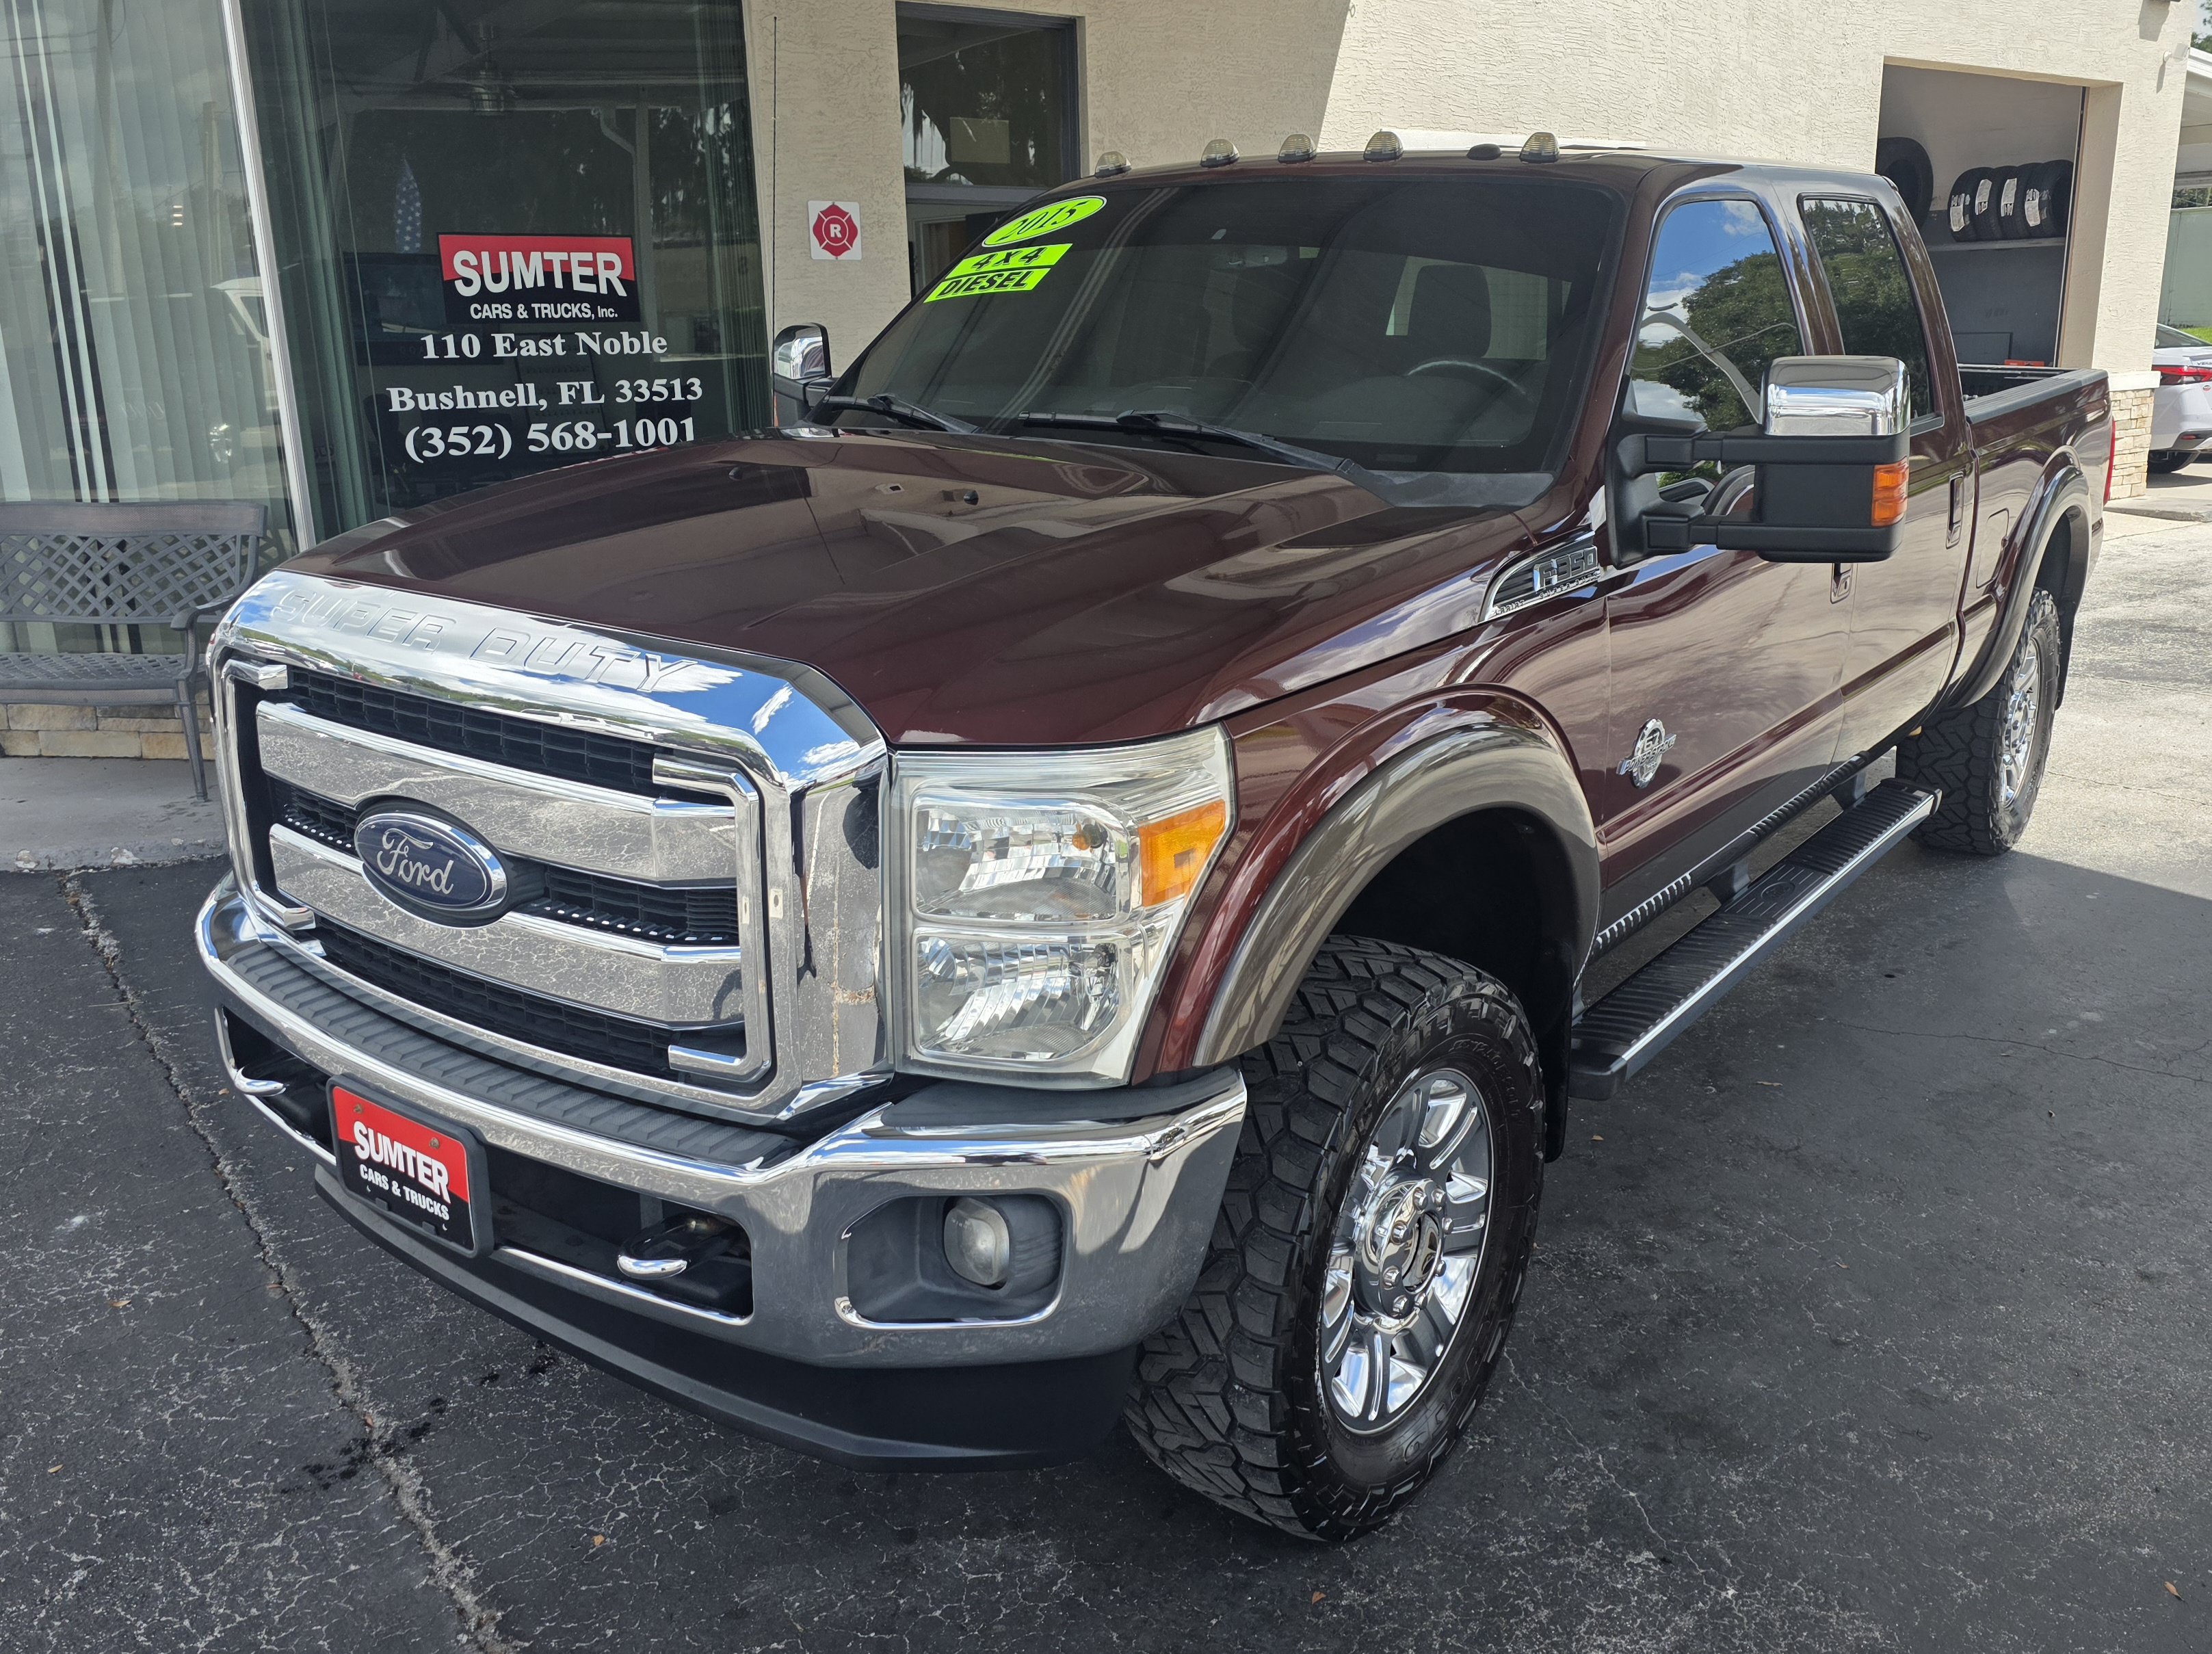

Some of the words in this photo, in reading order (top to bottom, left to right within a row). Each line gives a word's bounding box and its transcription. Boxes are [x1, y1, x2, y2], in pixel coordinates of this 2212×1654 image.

[830, 224, 842, 238] R
[997, 200, 1090, 242] 2015
[453, 250, 627, 297] SUMTER
[934, 270, 1034, 298] DIESEL
[470, 303, 513, 319] CARS
[516, 303, 529, 319] &
[531, 302, 594, 320] TRUCKS,
[597, 305, 618, 319] Inc.
[420, 333, 481, 359] 110
[490, 332, 567, 357] East
[574, 331, 668, 356] Noble
[386, 382, 548, 412] Bushnell,
[556, 380, 605, 405] FL
[615, 377, 703, 403] 33513
[405, 423, 512, 464] (352)
[527, 417, 694, 452] 568-1001
[269, 588, 458, 654] SUPER
[469, 626, 698, 692] DUTY
[377, 828, 454, 895] Ford
[353, 1120, 451, 1205] SUMTER
[359, 1164, 389, 1190] CARS
[391, 1180, 401, 1198] &
[402, 1185, 450, 1221] TRUCKS
